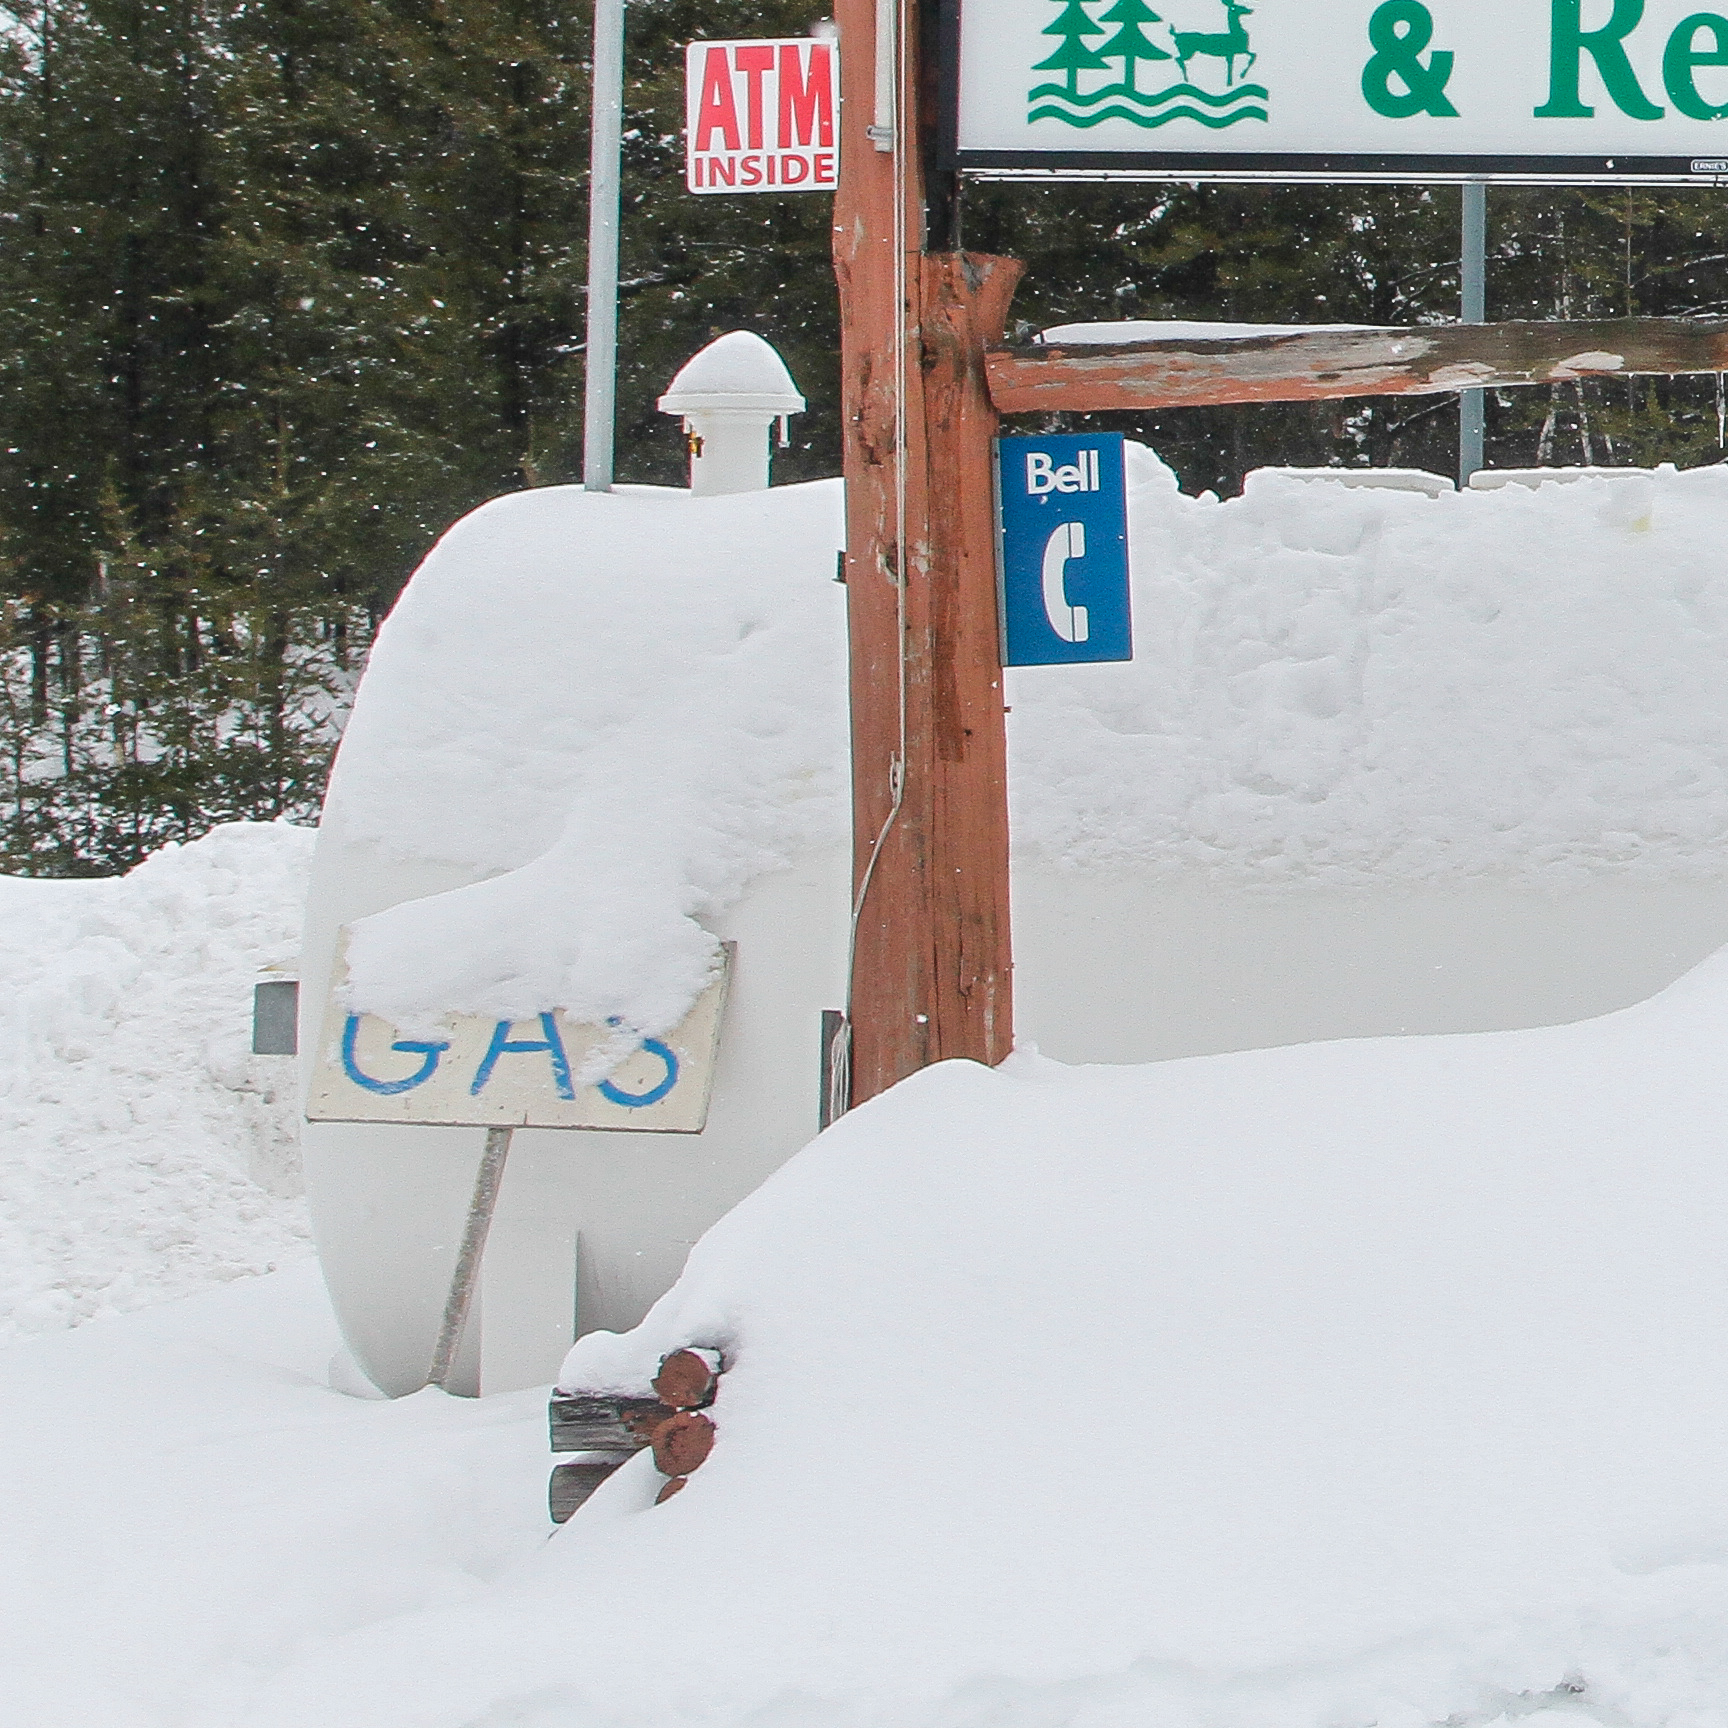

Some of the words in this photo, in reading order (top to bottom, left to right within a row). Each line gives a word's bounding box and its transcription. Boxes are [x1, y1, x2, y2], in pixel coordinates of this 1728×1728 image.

[694, 43, 835, 152] ATM
[694, 153, 836, 188] INSIDE
[1026, 450, 1099, 495] Bell
[340, 1011, 680, 1109] GAS
